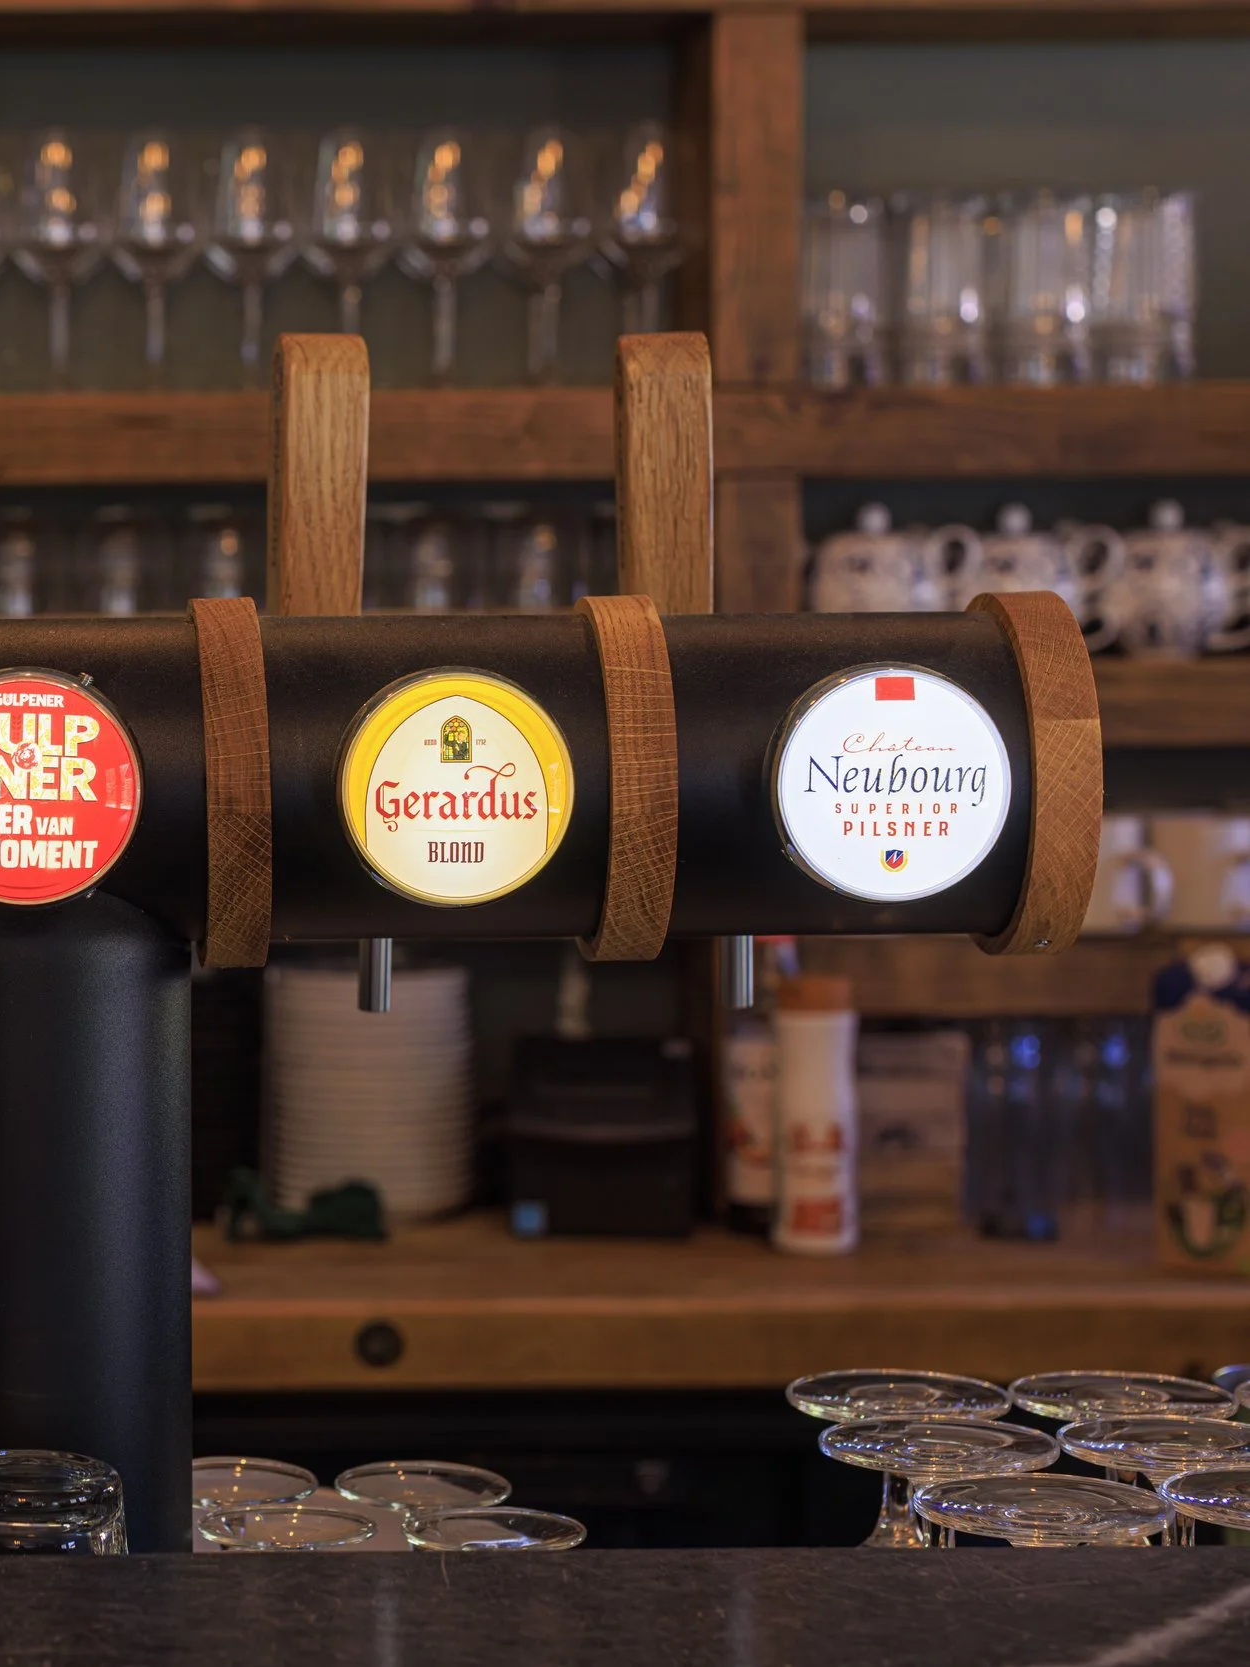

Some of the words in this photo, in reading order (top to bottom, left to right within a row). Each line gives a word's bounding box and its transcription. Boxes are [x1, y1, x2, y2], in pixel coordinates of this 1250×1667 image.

[803, 753, 988, 807] Neubourg
[375, 762, 538, 832] Gerardus
[835, 803, 958, 815] SUPERIOR
[35, 817, 74, 835] VAN
[843, 821, 949, 837] PILSNER
[427, 841, 485, 863] BLOND
